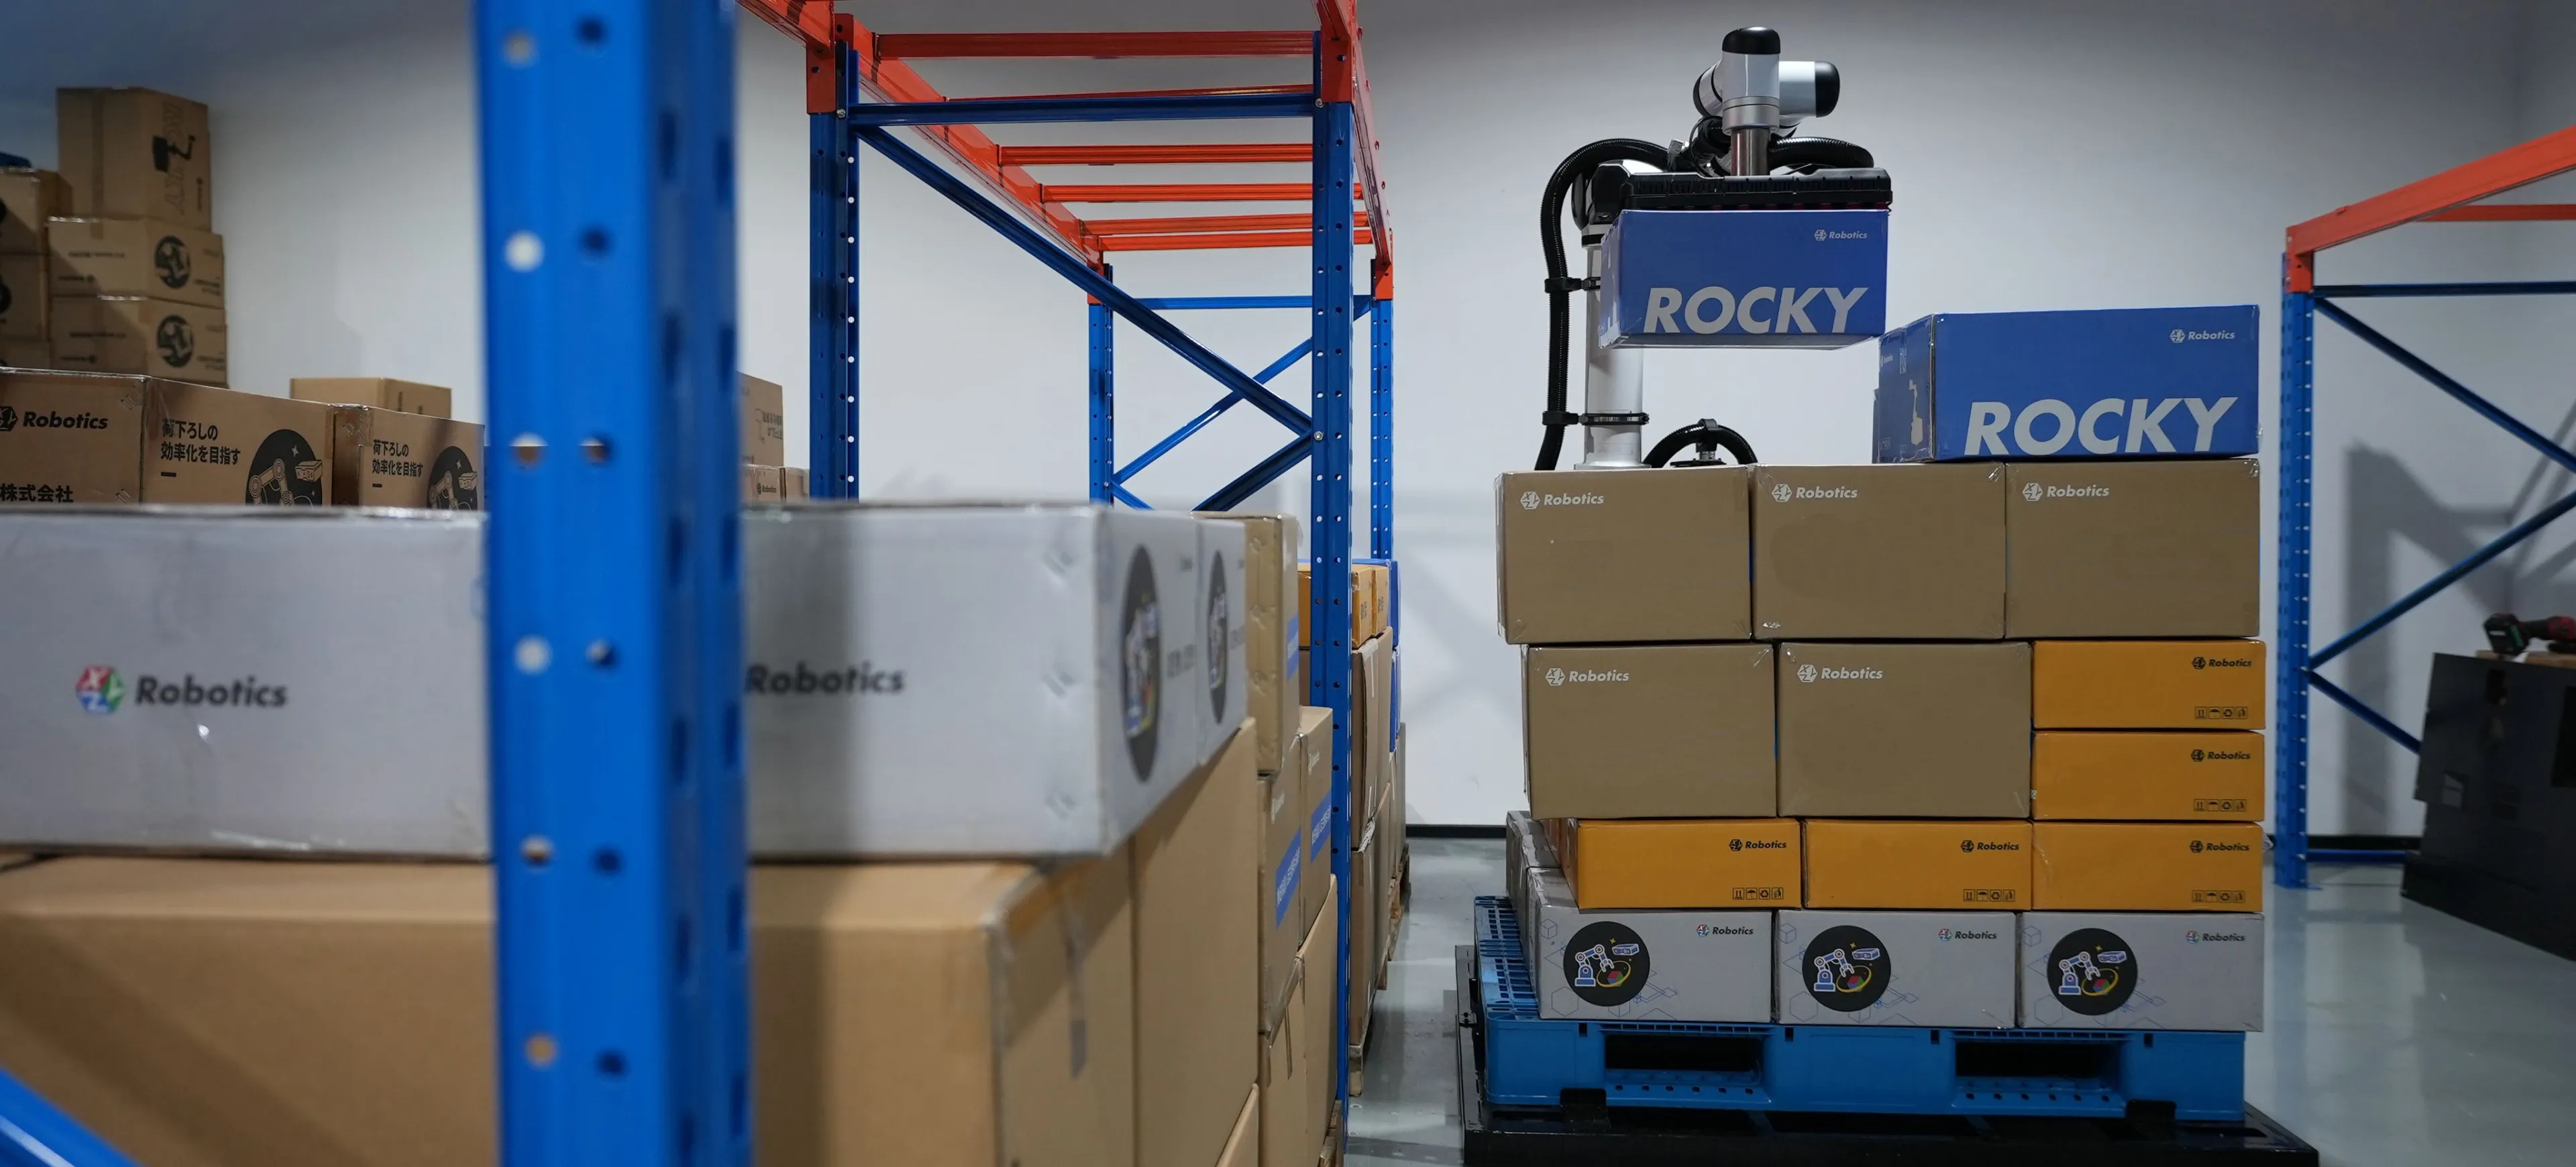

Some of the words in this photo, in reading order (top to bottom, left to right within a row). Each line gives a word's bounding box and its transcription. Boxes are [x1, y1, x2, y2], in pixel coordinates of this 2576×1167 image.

[1829, 231, 1868, 239] Robotics
[1643, 286, 1868, 335] ROCKY
[2188, 330, 2235, 340] Robotics
[23, 411, 109, 430] Robotics
[1964, 396, 2239, 457] ROCKY
[162, 418, 219, 441] 荷下ろしの
[160, 440, 241, 465] 効率化を目指す
[373, 439, 409, 458] 荷下ろしの
[372, 458, 423, 478] 効率化を目指す
[0, 483, 73, 502] 株式会社
[1796, 486, 1858, 499] Robotics
[2047, 484, 2110, 498] Robotics
[1544, 492, 1605, 506] Robotics
[2209, 659, 2253, 667] Robotics
[744, 660, 906, 696] Robotics
[1569, 669, 1629, 683] Robotics
[1821, 667, 1883, 680] Robotics
[135, 673, 288, 708] Robotics
[2208, 751, 2251, 761] Robotics
[1746, 840, 1787, 850] Robotics
[1977, 842, 2020, 851] Robotics
[2206, 842, 2251, 852] Robotics
[1712, 926, 1754, 936] Robotics
[1955, 931, 1997, 940] Robotics
[2202, 933, 2246, 943] Robotics
